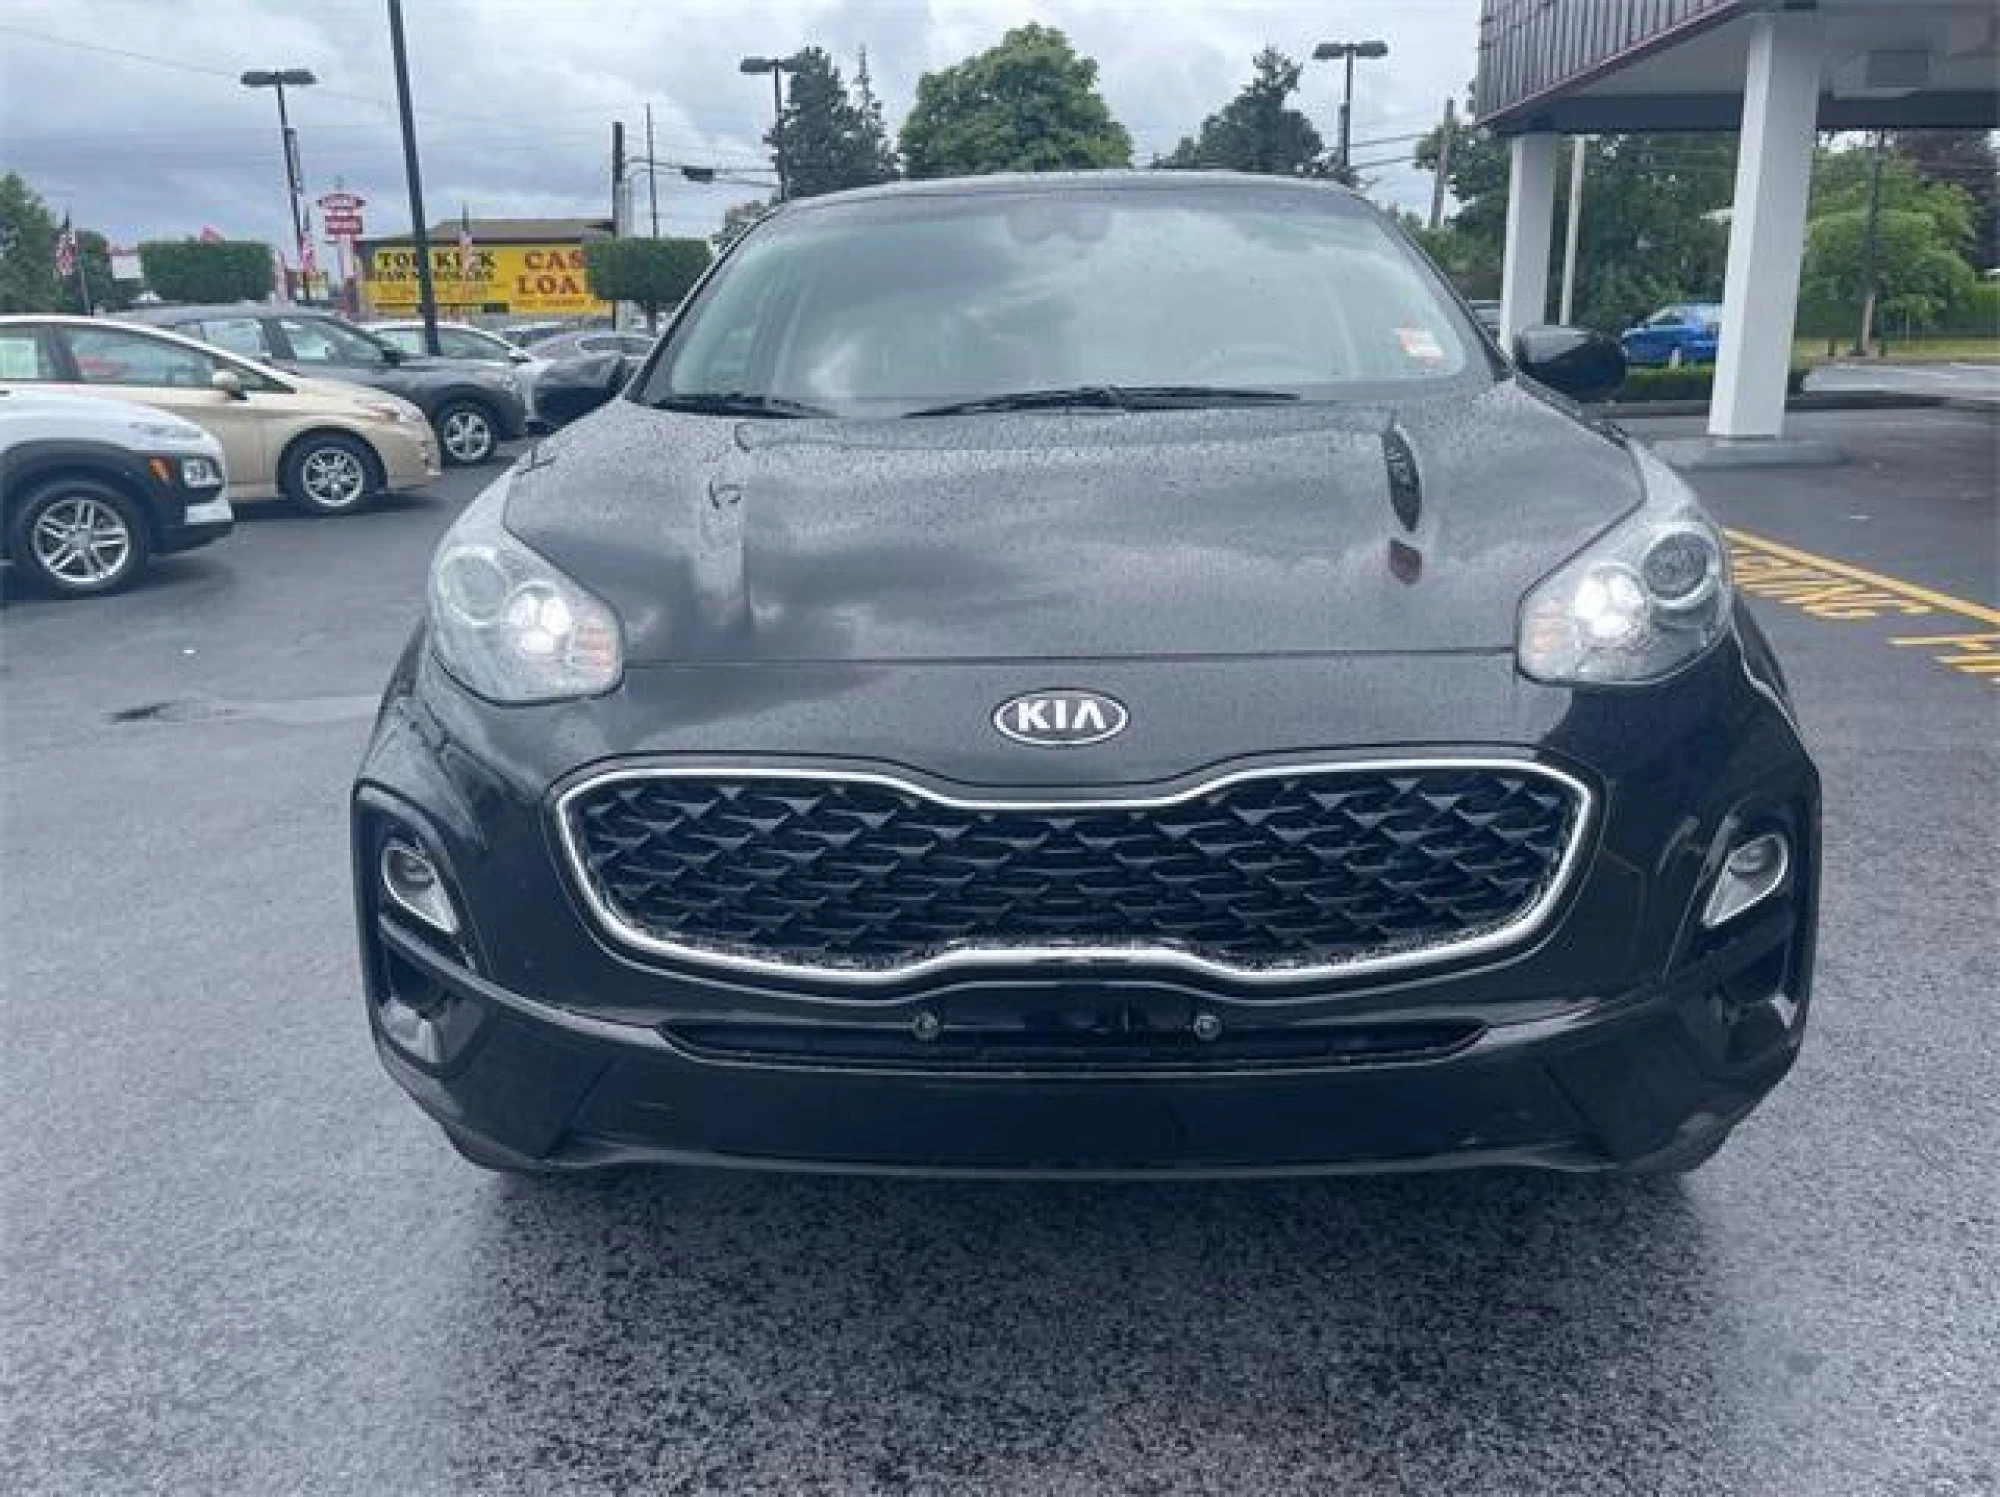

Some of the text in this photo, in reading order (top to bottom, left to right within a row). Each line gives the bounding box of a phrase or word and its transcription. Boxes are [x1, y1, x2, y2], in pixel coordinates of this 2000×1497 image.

[433, 252, 496, 268] KIK
[524, 250, 589, 270] CAS
[517, 275, 590, 295] LOA
[1018, 699, 1107, 731] KIA
